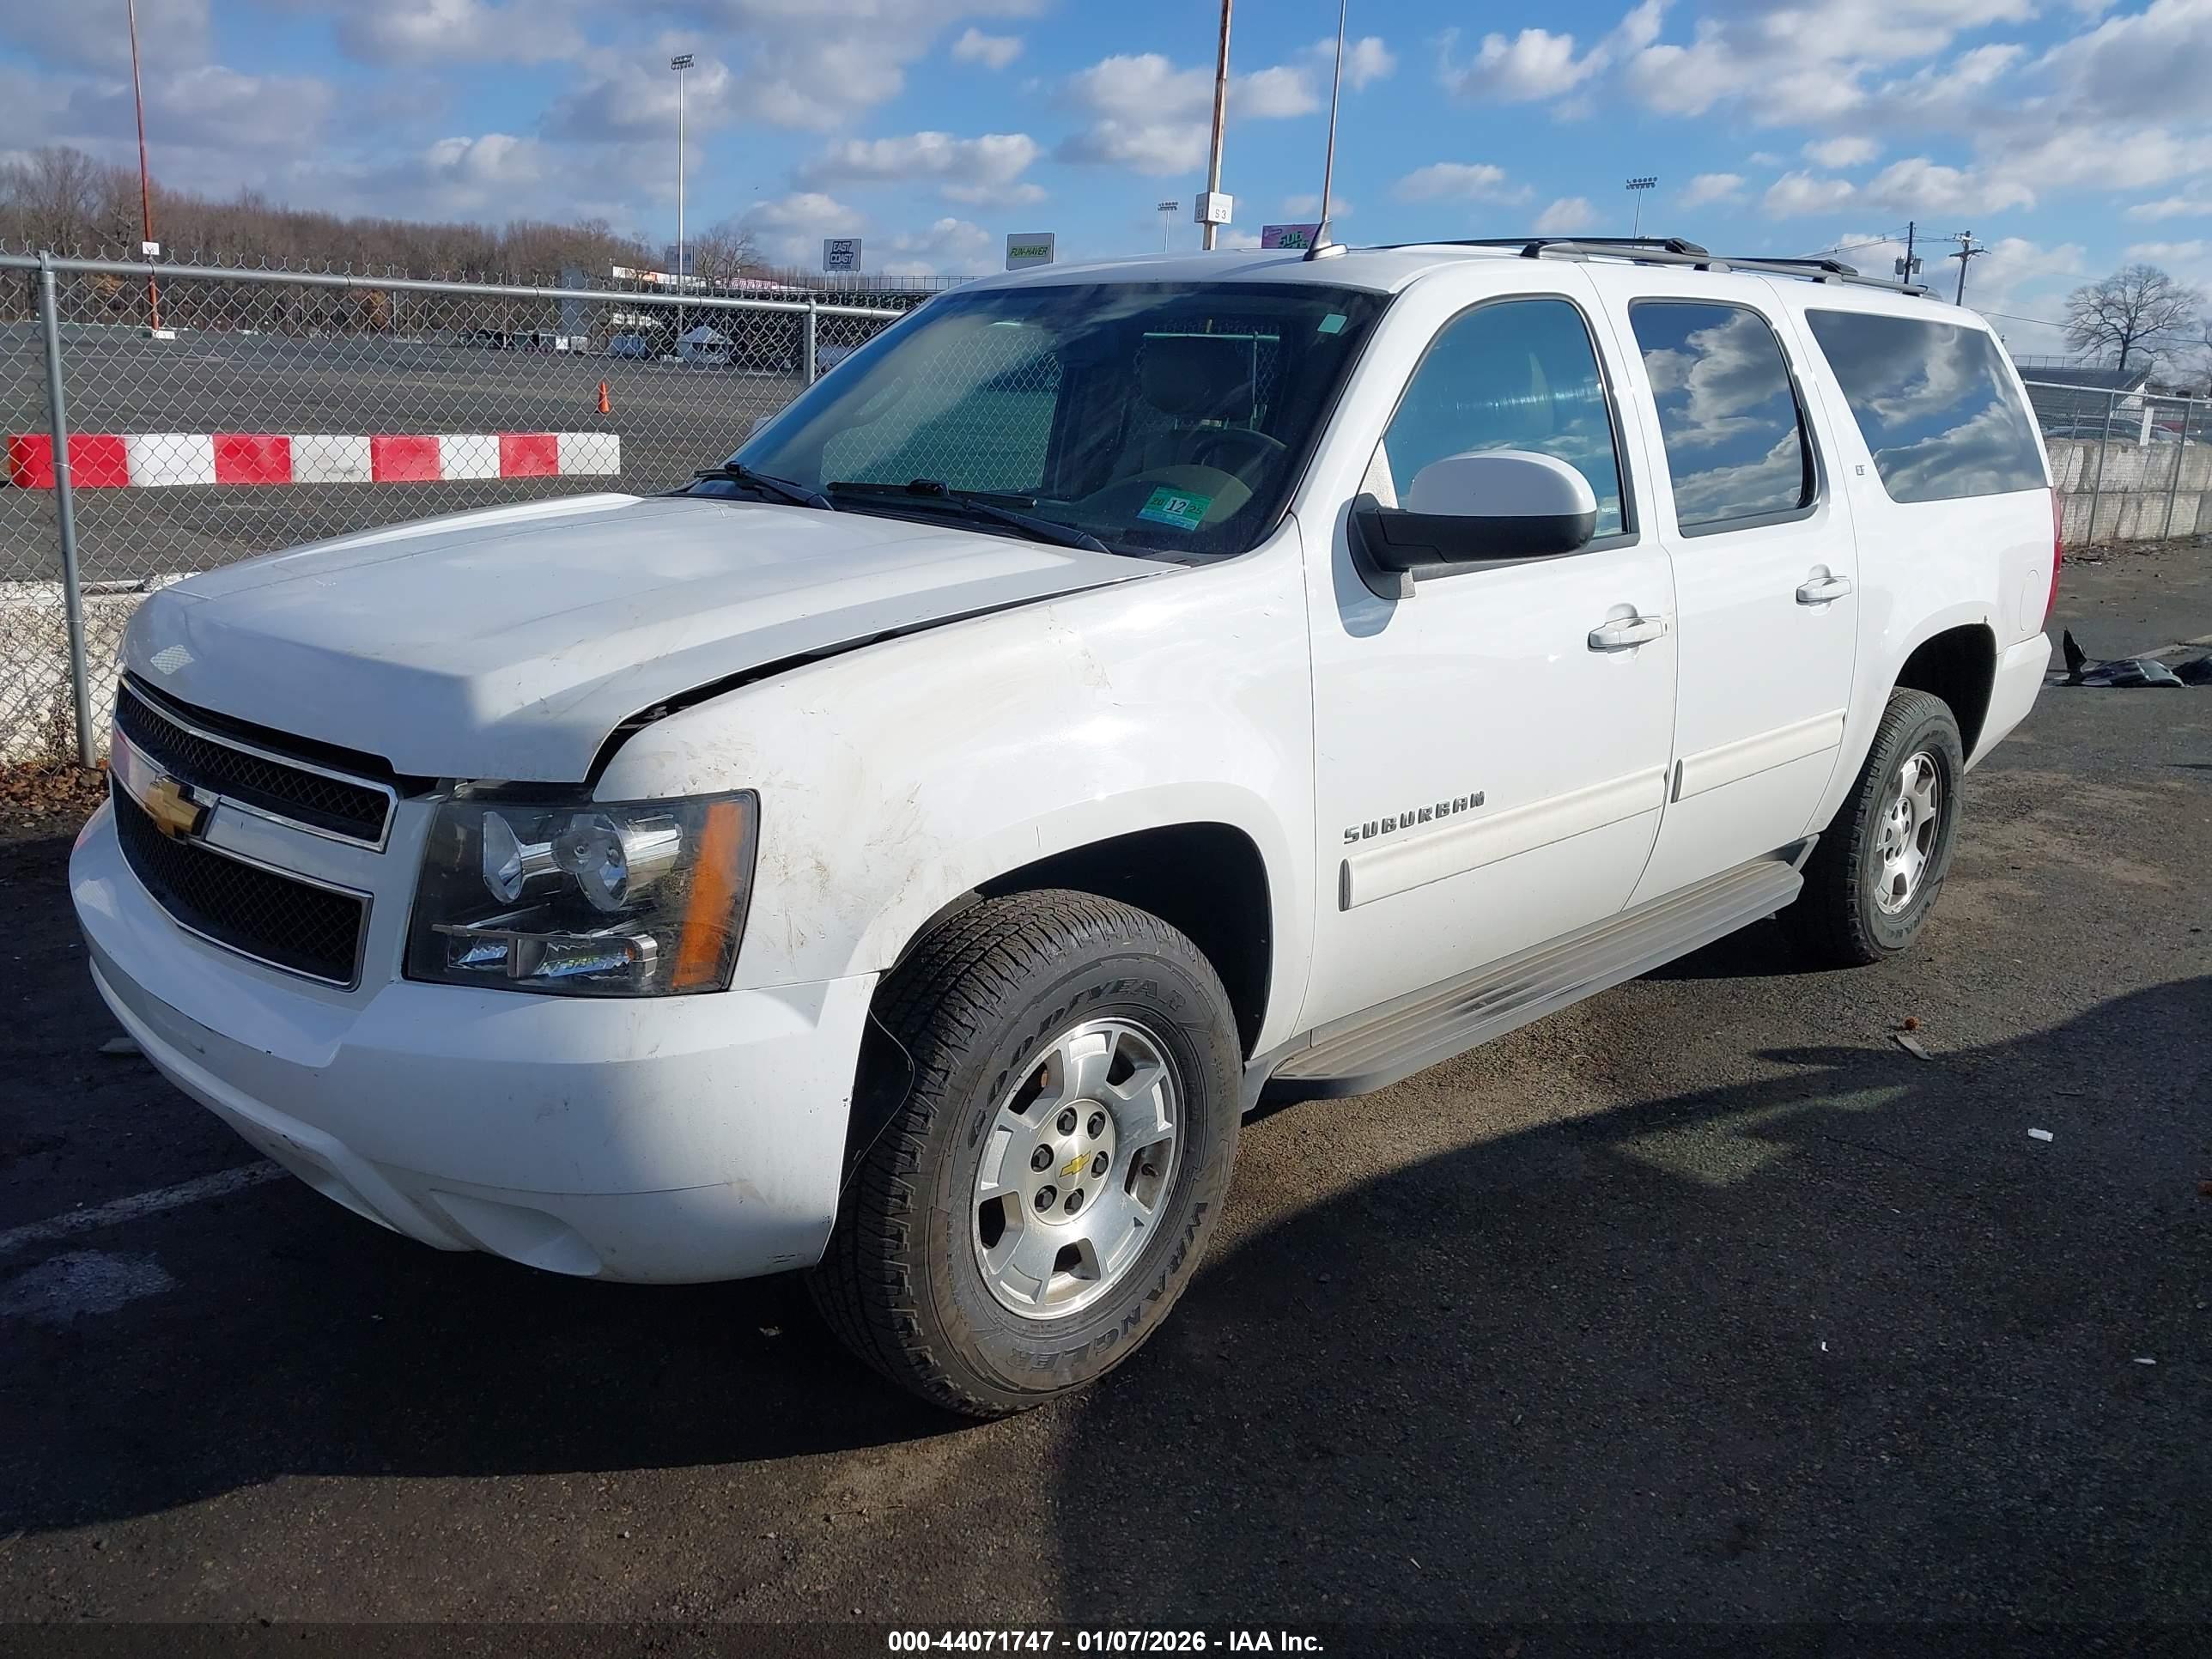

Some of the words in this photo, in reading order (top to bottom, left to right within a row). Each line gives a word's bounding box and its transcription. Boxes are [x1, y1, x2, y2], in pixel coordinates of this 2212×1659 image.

[833, 241, 852, 252] EAST
[830, 252, 854, 264] COAST
[1167, 499, 1187, 513] 12
[1343, 790, 1486, 845] SUBURBAN
[1005, 1201, 1209, 1372] WRANGLER
